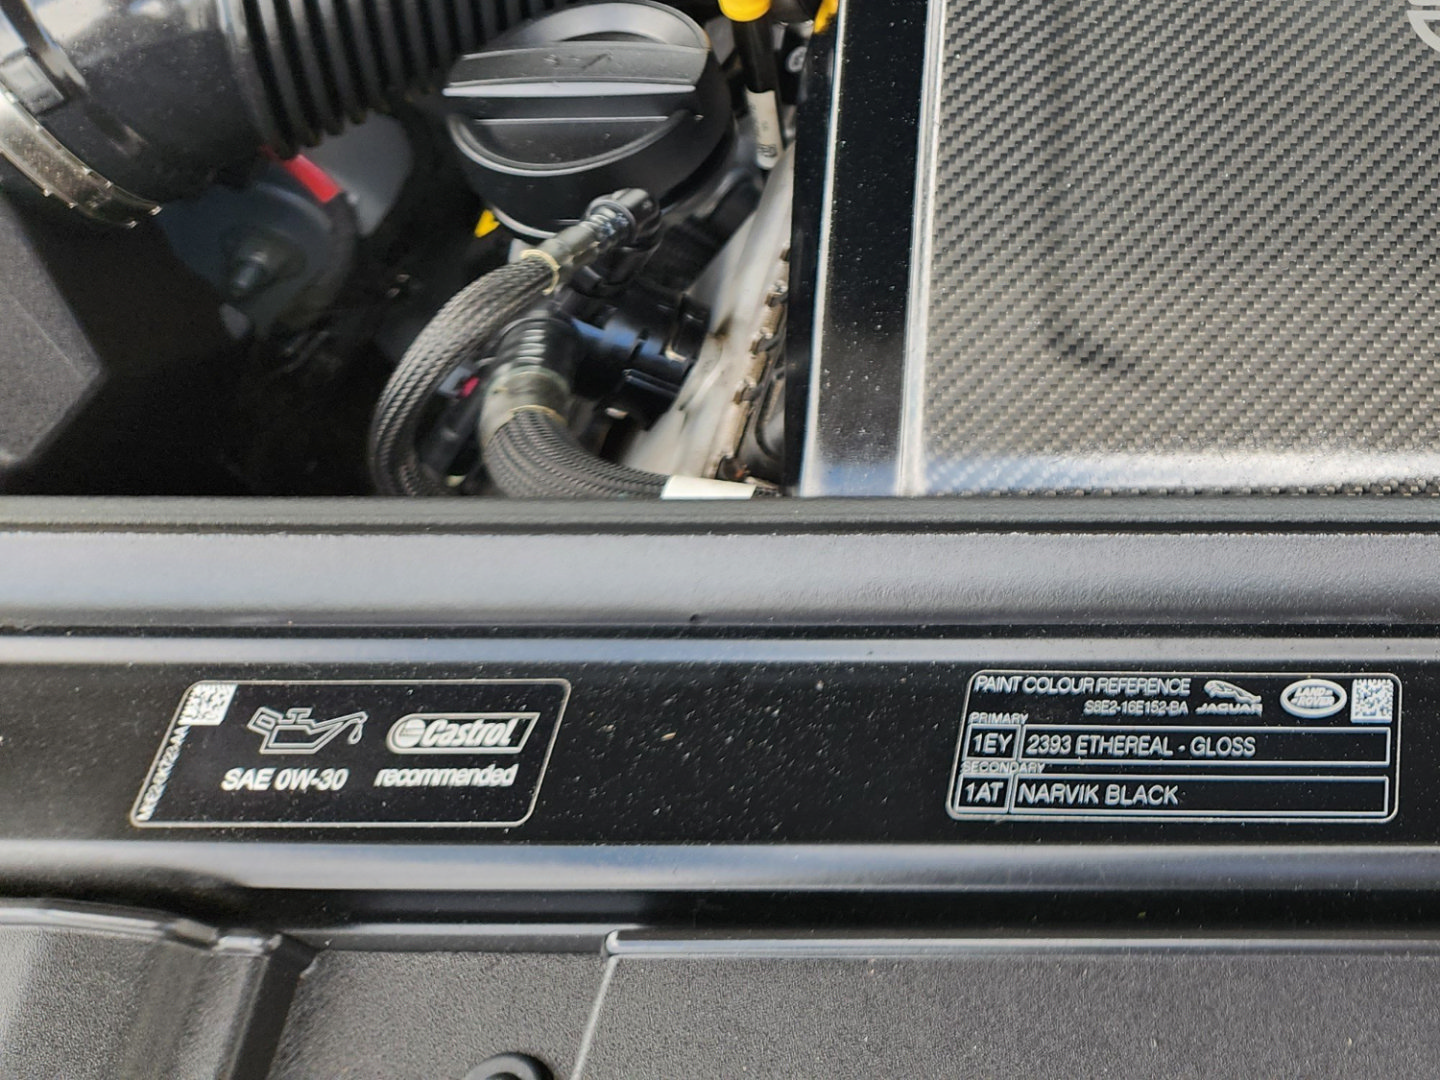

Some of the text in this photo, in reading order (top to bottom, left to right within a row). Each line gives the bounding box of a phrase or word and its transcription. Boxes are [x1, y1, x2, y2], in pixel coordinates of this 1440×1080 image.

[974, 676, 1191, 696] PAINT COLOUR REFERENCE
[1295, 687, 1328, 697] LAND
[1195, 703, 1263, 717] JAGUAR
[1298, 696, 1335, 706] ROVER
[968, 711, 1028, 724] PRIMARY
[421, 718, 516, 747] Castrol
[972, 731, 1013, 755] 1EY
[1025, 734, 1072, 755] 2393
[1074, 735, 1174, 757] ETHEREAL
[1189, 736, 1256, 757] GLOSS
[221, 767, 350, 791] SAE 0W-30
[374, 763, 520, 787] recommended
[960, 761, 1046, 774] SECONDARY
[964, 781, 1004, 804] 1AT
[1017, 783, 1180, 806] NARVIK BLACK
